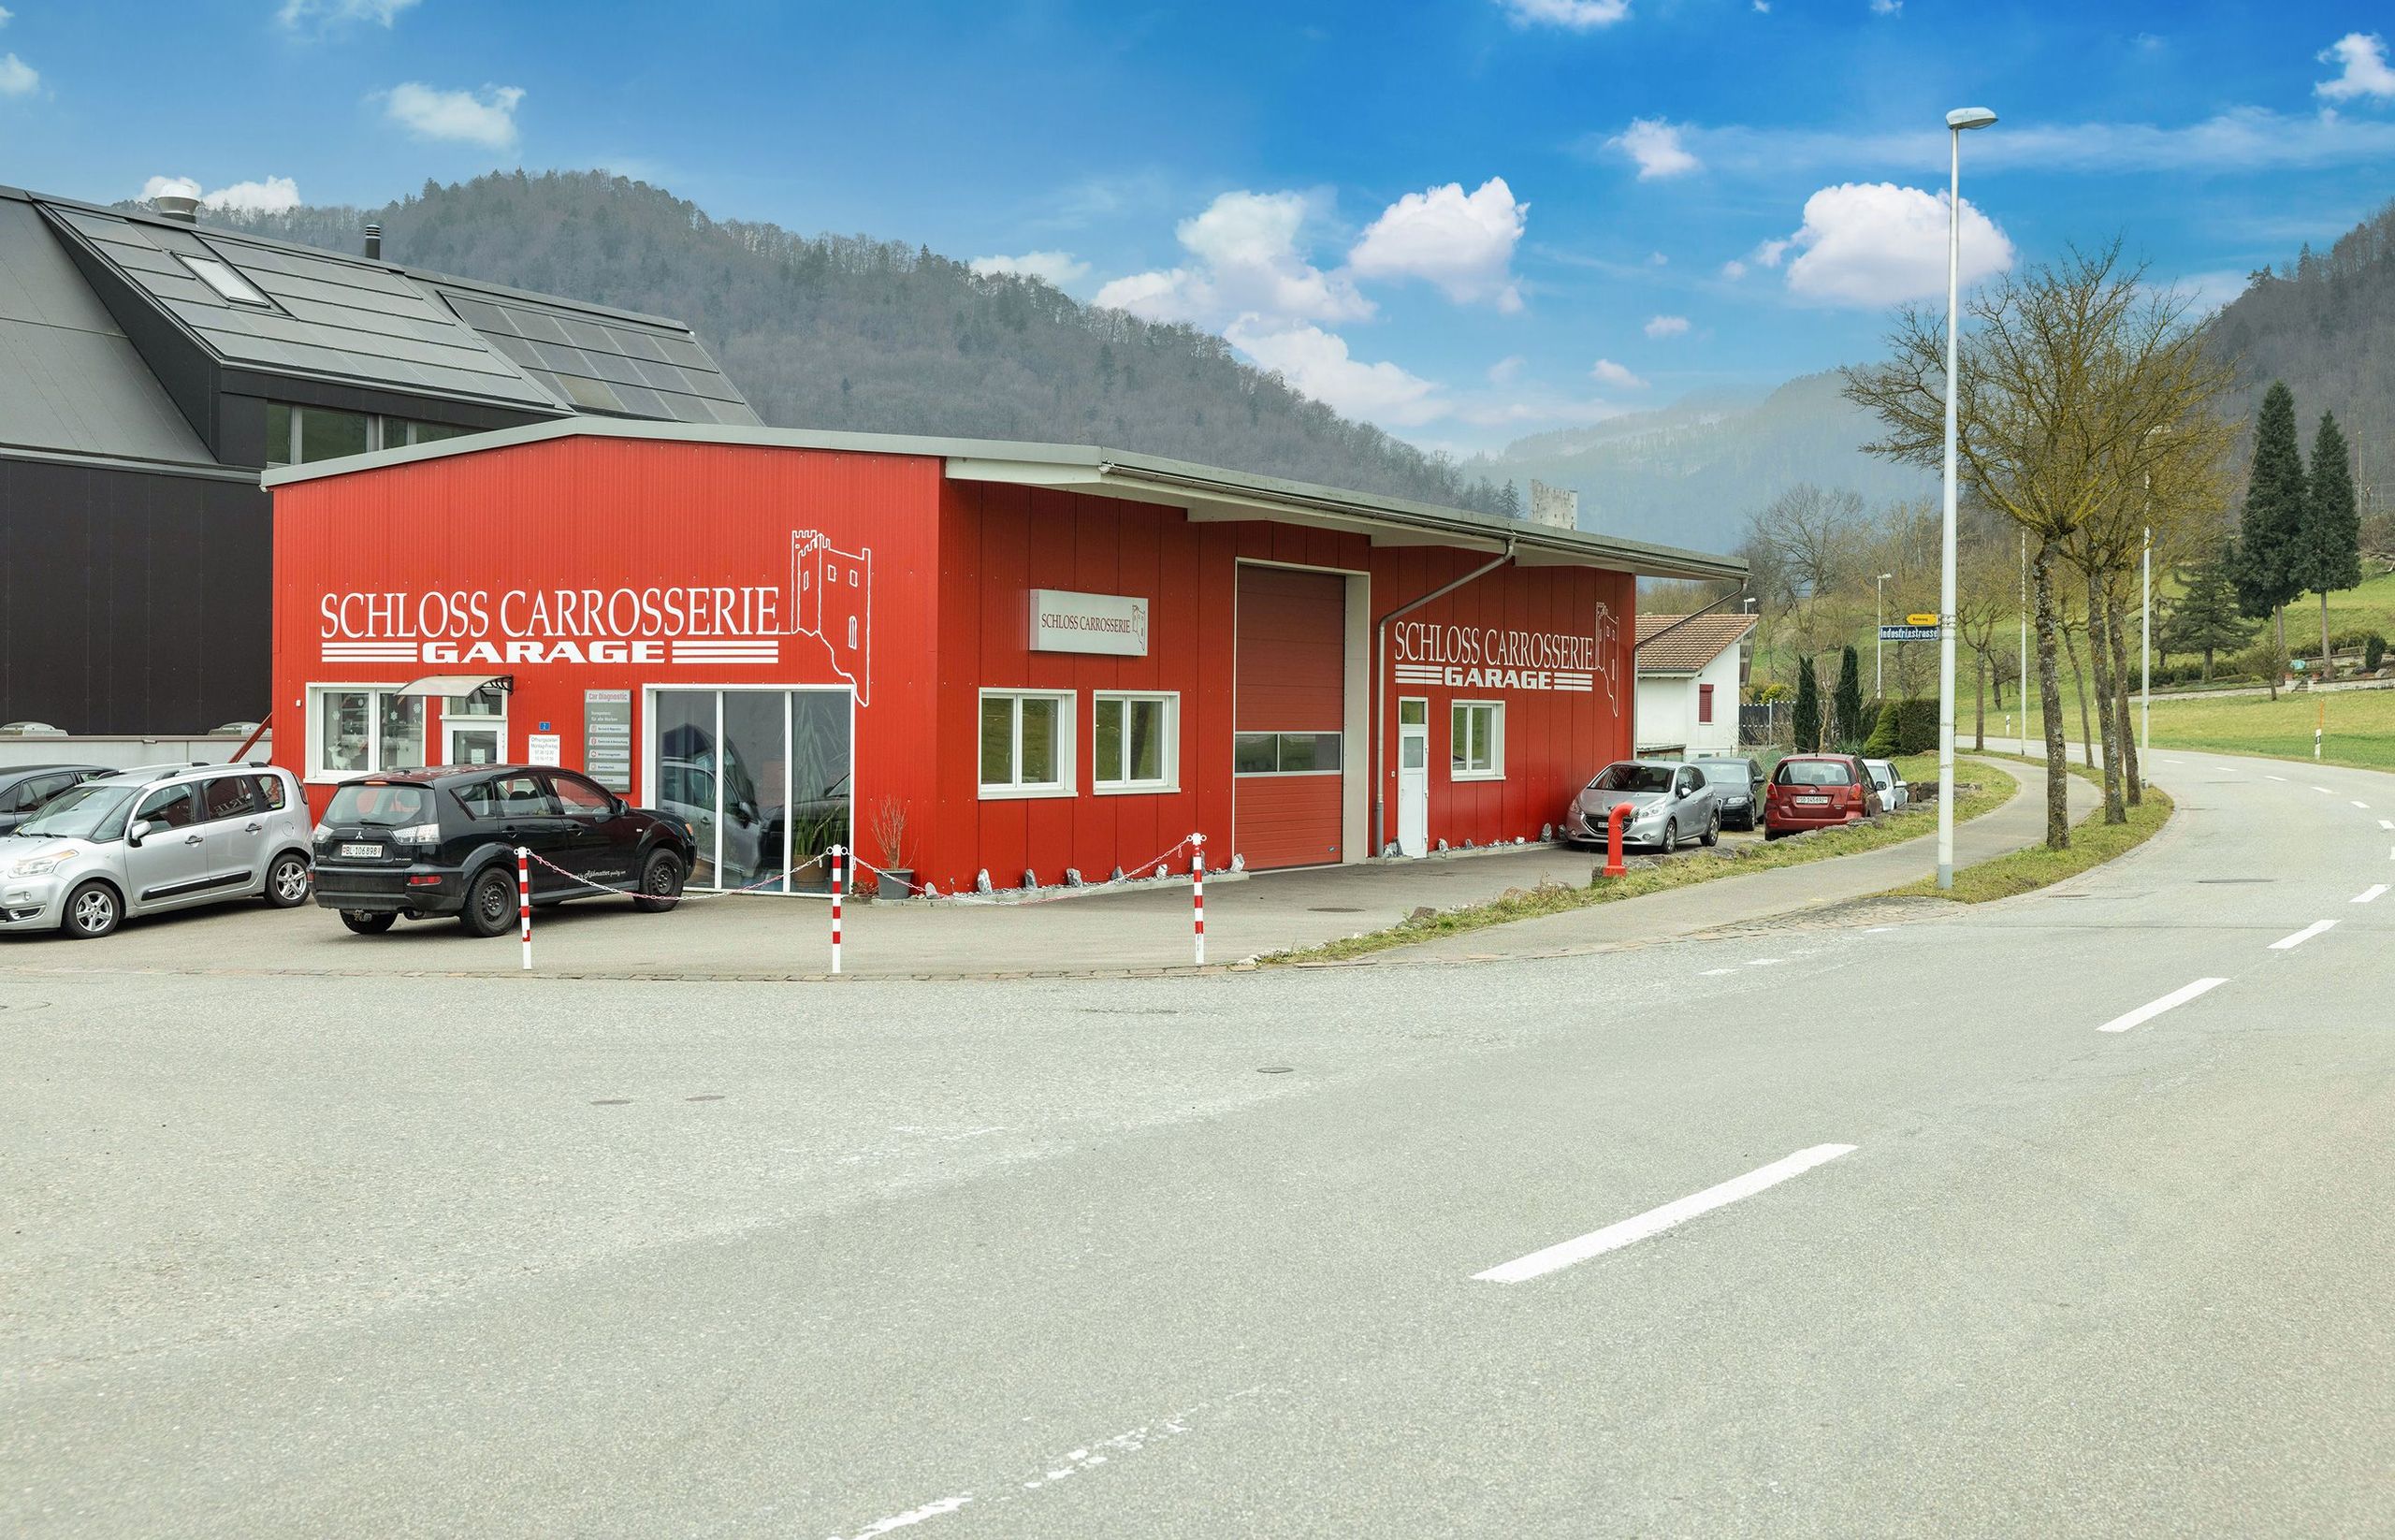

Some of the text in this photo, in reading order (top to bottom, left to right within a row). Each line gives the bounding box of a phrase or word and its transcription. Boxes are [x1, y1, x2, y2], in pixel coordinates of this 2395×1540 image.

[321, 587, 779, 639] SCHLOSS CARROSSERIE
[1041, 614, 1130, 633] SCHLOSS CARROSSERIE
[1880, 628, 1938, 639] Industriestrasse
[422, 640, 665, 664] GARAGE
[1395, 621, 1593, 671] SCHLOSS CARROSSERIE
[1444, 666, 1553, 690] GARAGE
